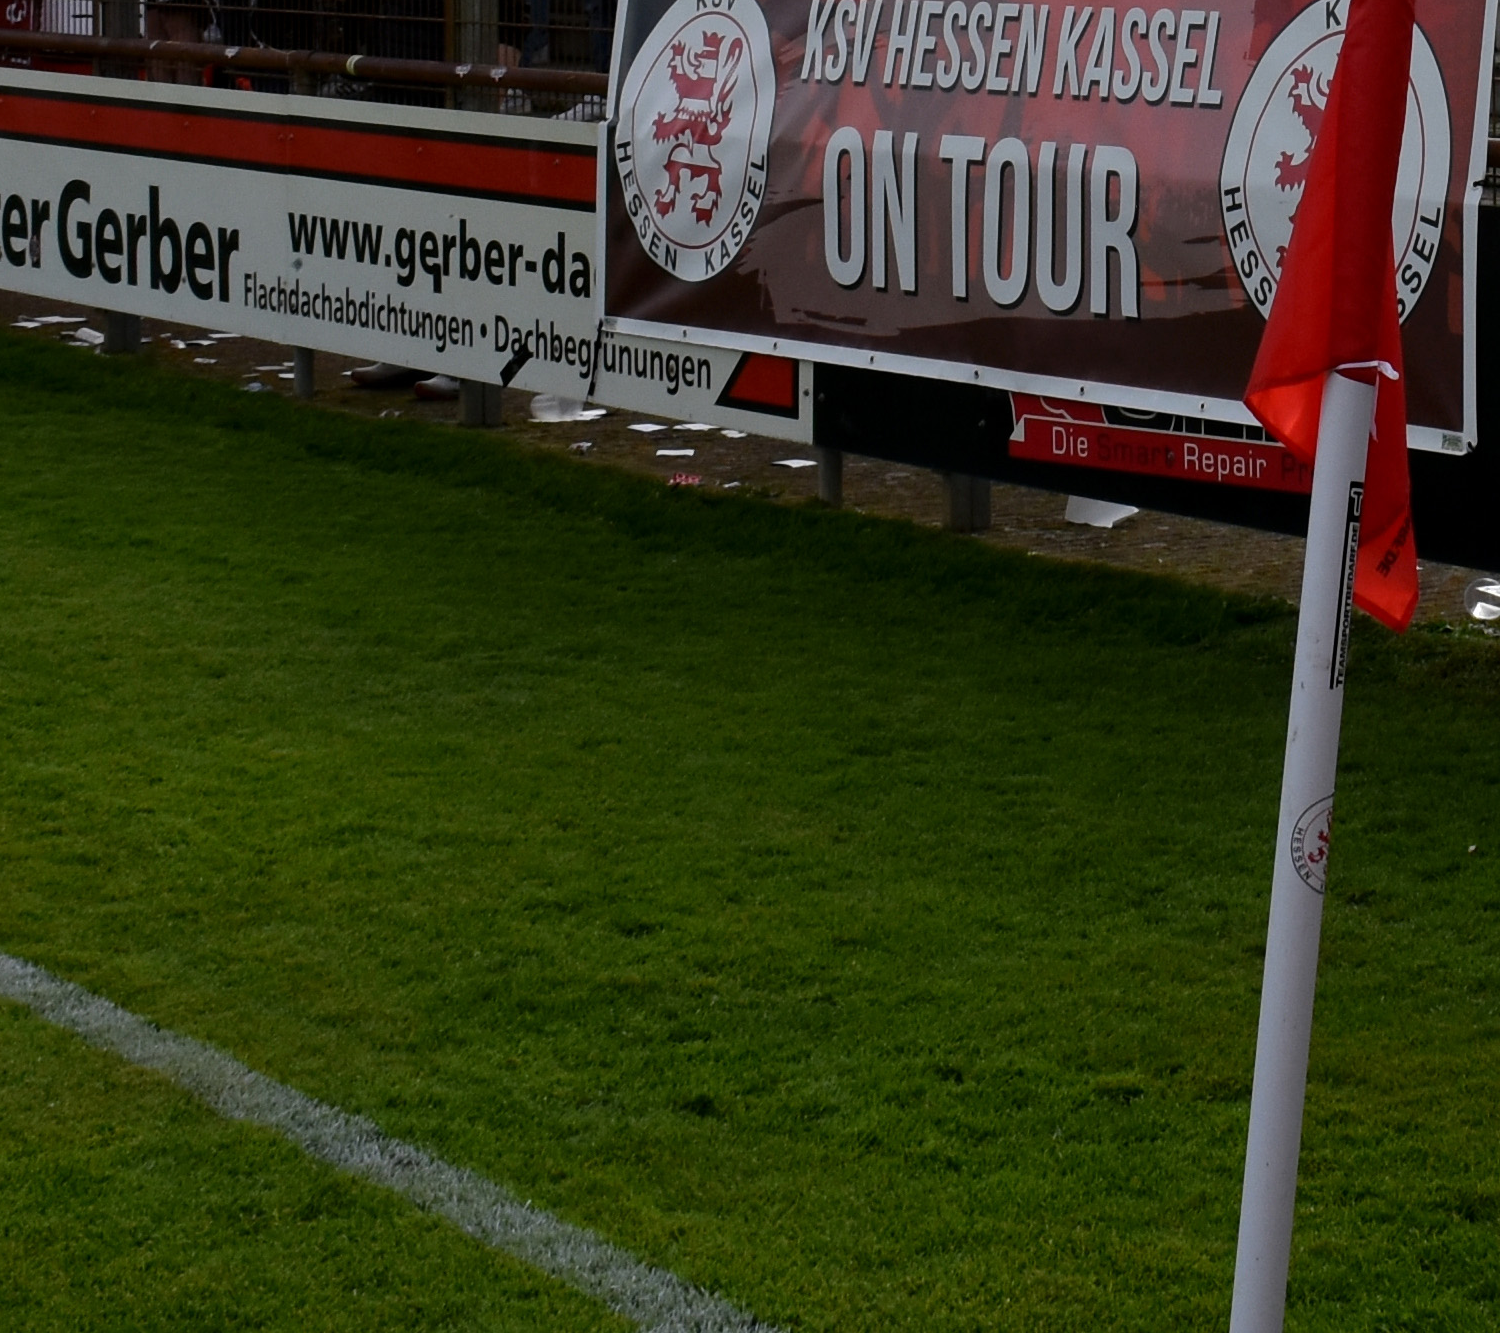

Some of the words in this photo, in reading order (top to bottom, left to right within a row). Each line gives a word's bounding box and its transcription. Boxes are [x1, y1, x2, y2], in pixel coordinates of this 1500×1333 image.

[881, 0, 1049, 96] HESSEN
[1051, 6, 1224, 110] KASSEL
[57, 179, 239, 303] Gerber
[288, 211, 592, 299] www.gerber-da
[616, 140, 678, 272] HESSEN
[704, 153, 766, 276] KASSEL
[823, 125, 918, 296] ON
[939, 133, 1140, 321] TOUR
[1223, 186, 1273, 308] HESS
[243, 272, 474, 352] Flachdachabdichtungen
[494, 316, 712, 395] Dachbegrünungen
[1051, 425, 1089, 458] Die
[1097, 436, 1176, 468] Smart
[1183, 441, 1267, 482] Repair
